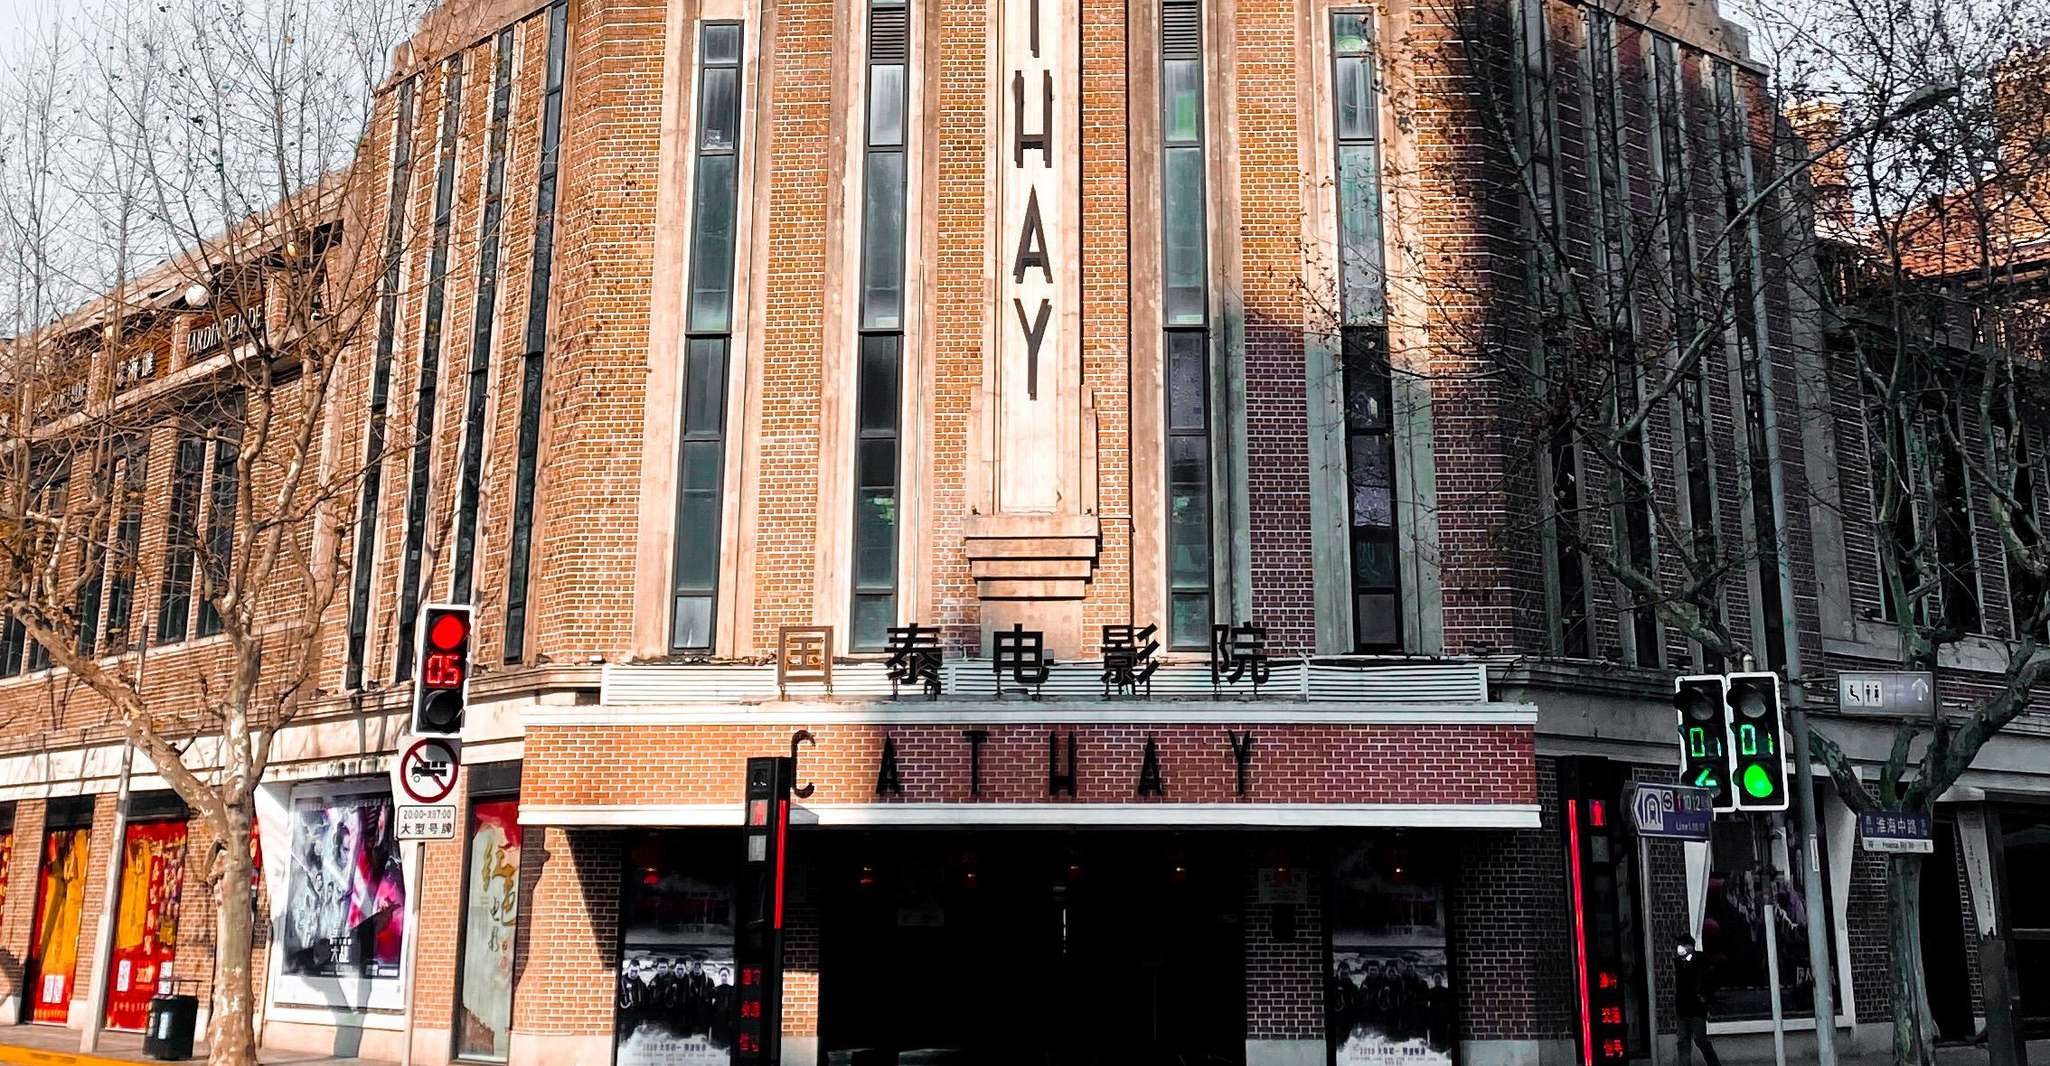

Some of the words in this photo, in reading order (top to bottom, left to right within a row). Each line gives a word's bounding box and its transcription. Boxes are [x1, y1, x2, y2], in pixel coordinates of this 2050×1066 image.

[778, 622, 1271, 685] 国泰电影院
[426, 654, 460, 686] 05
[791, 729, 1252, 798] CATHAY
[400, 823, 452, 835] 大型号牌
[1876, 816, 1917, 835] 淮海中路
